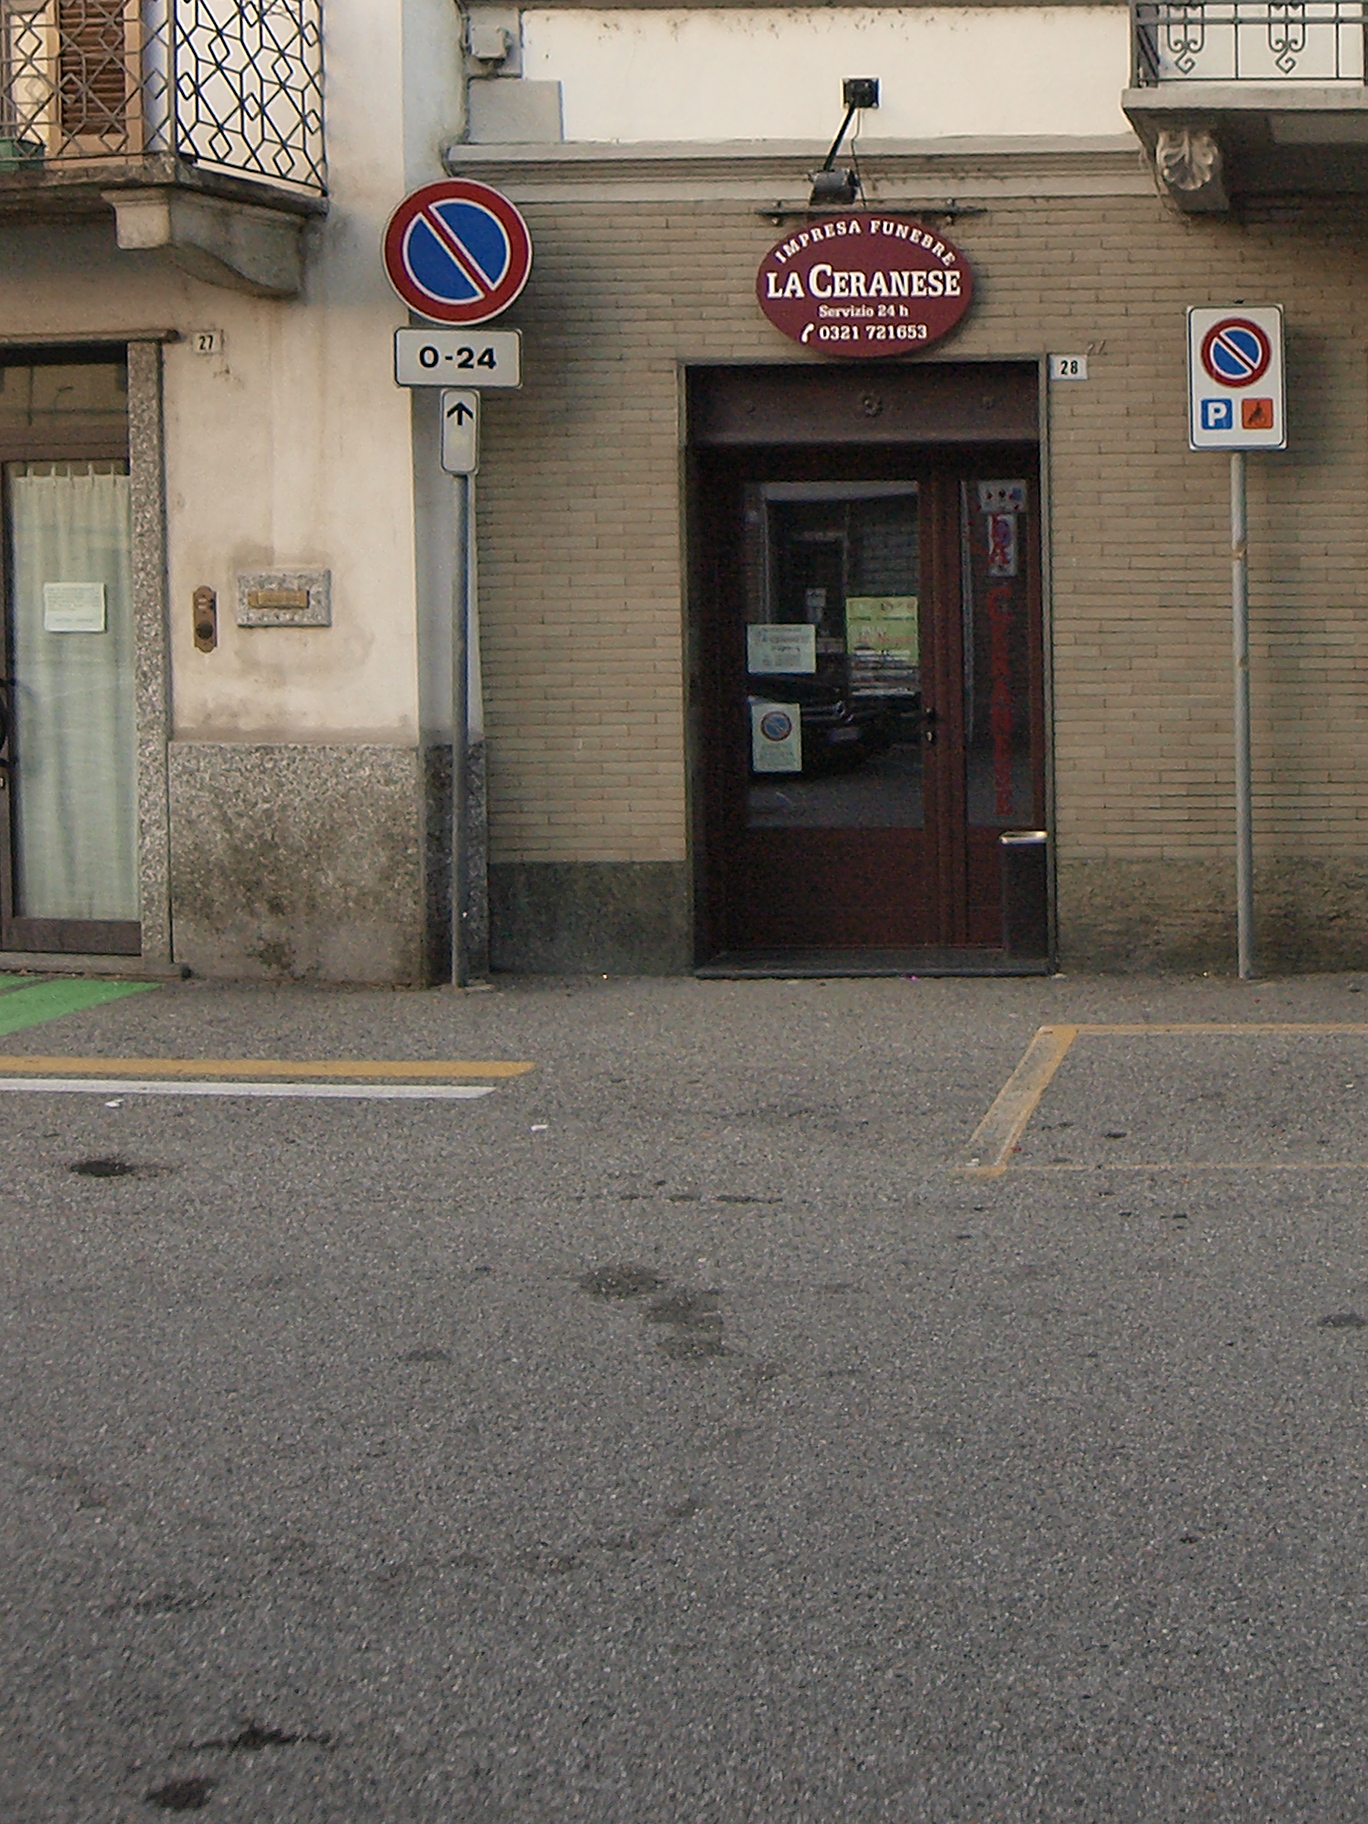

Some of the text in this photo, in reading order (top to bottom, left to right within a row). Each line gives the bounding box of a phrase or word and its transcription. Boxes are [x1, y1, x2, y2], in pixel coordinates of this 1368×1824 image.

[774, 220, 956, 266] IMPRESA FUNEBRE
[766, 263, 961, 298] LA CERANESE
[818, 304, 909, 319] Servizio 24 h
[819, 325, 927, 340] 0321 721653
[199, 334, 213, 350] 27
[1060, 359, 1078, 375] 28
[1207, 401, 1228, 427] P
